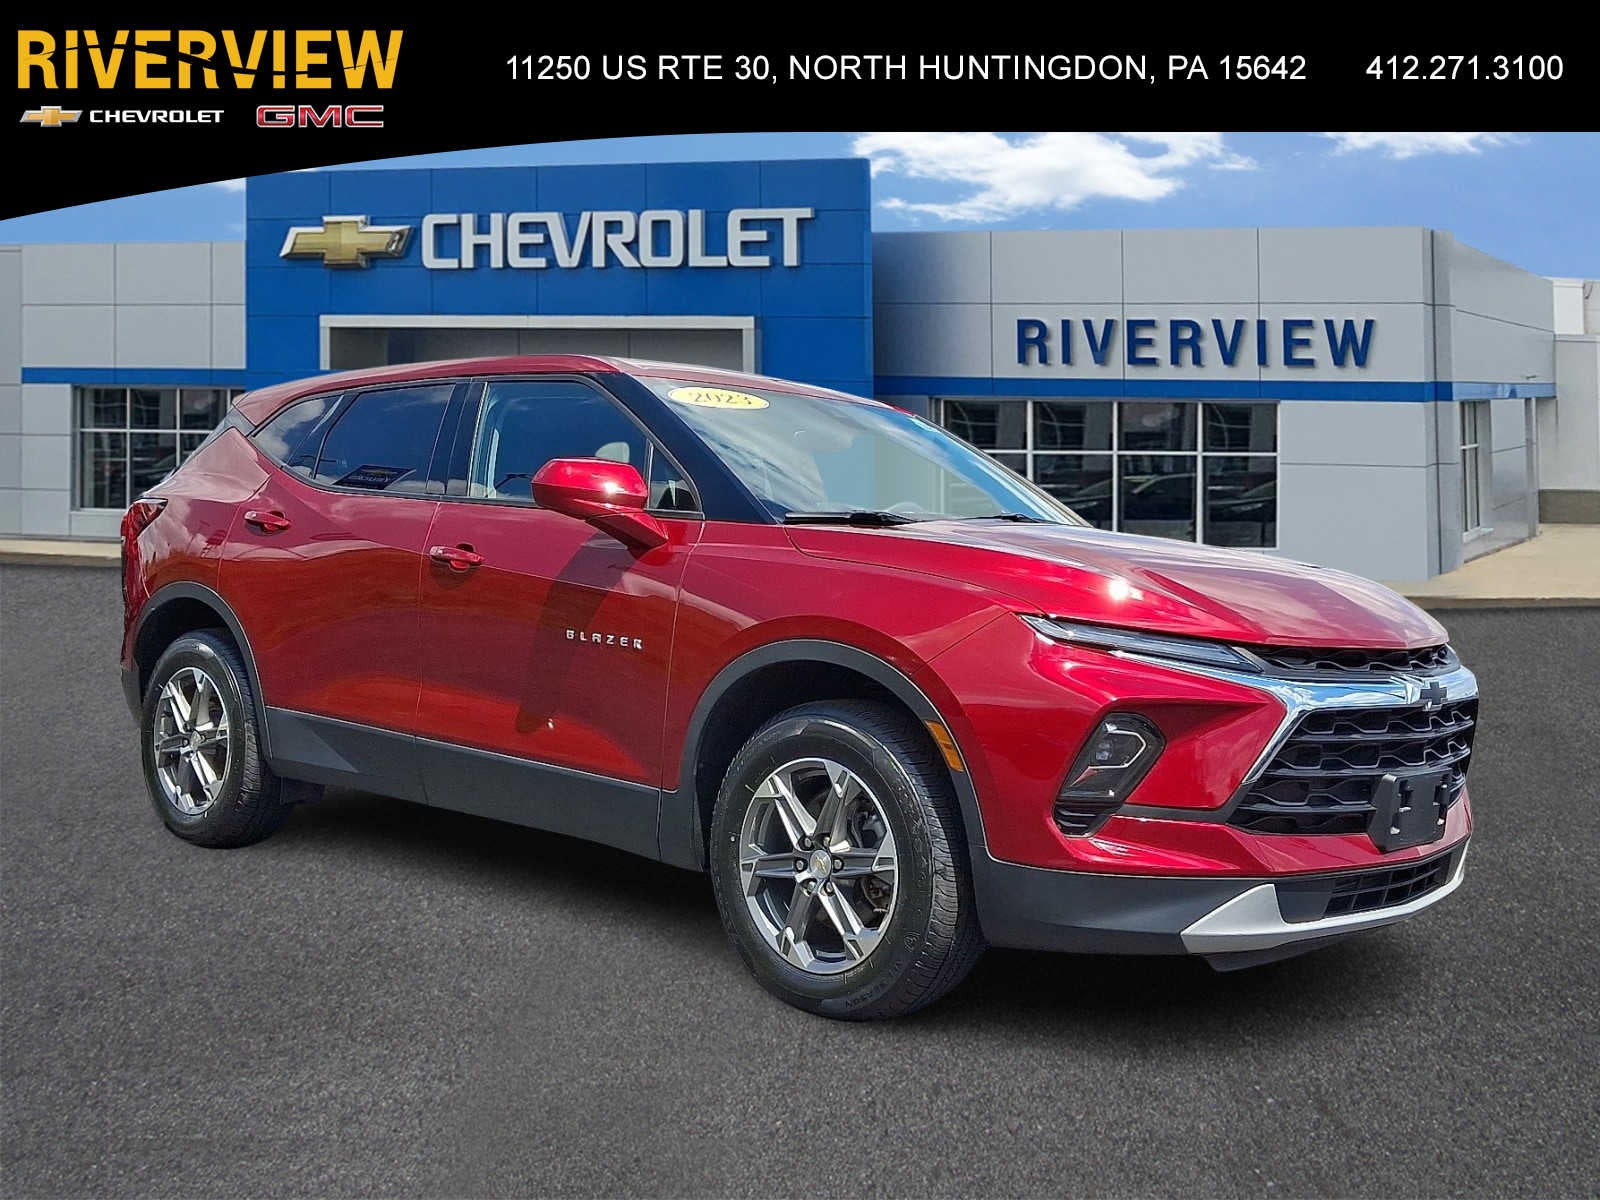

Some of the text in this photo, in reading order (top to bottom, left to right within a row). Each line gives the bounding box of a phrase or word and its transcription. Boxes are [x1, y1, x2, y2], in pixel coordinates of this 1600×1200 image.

[422, 208, 813, 269] CHEVROLET
[1016, 318, 1375, 367] RIVERVIEW
[566, 629, 642, 649] BLAZER
